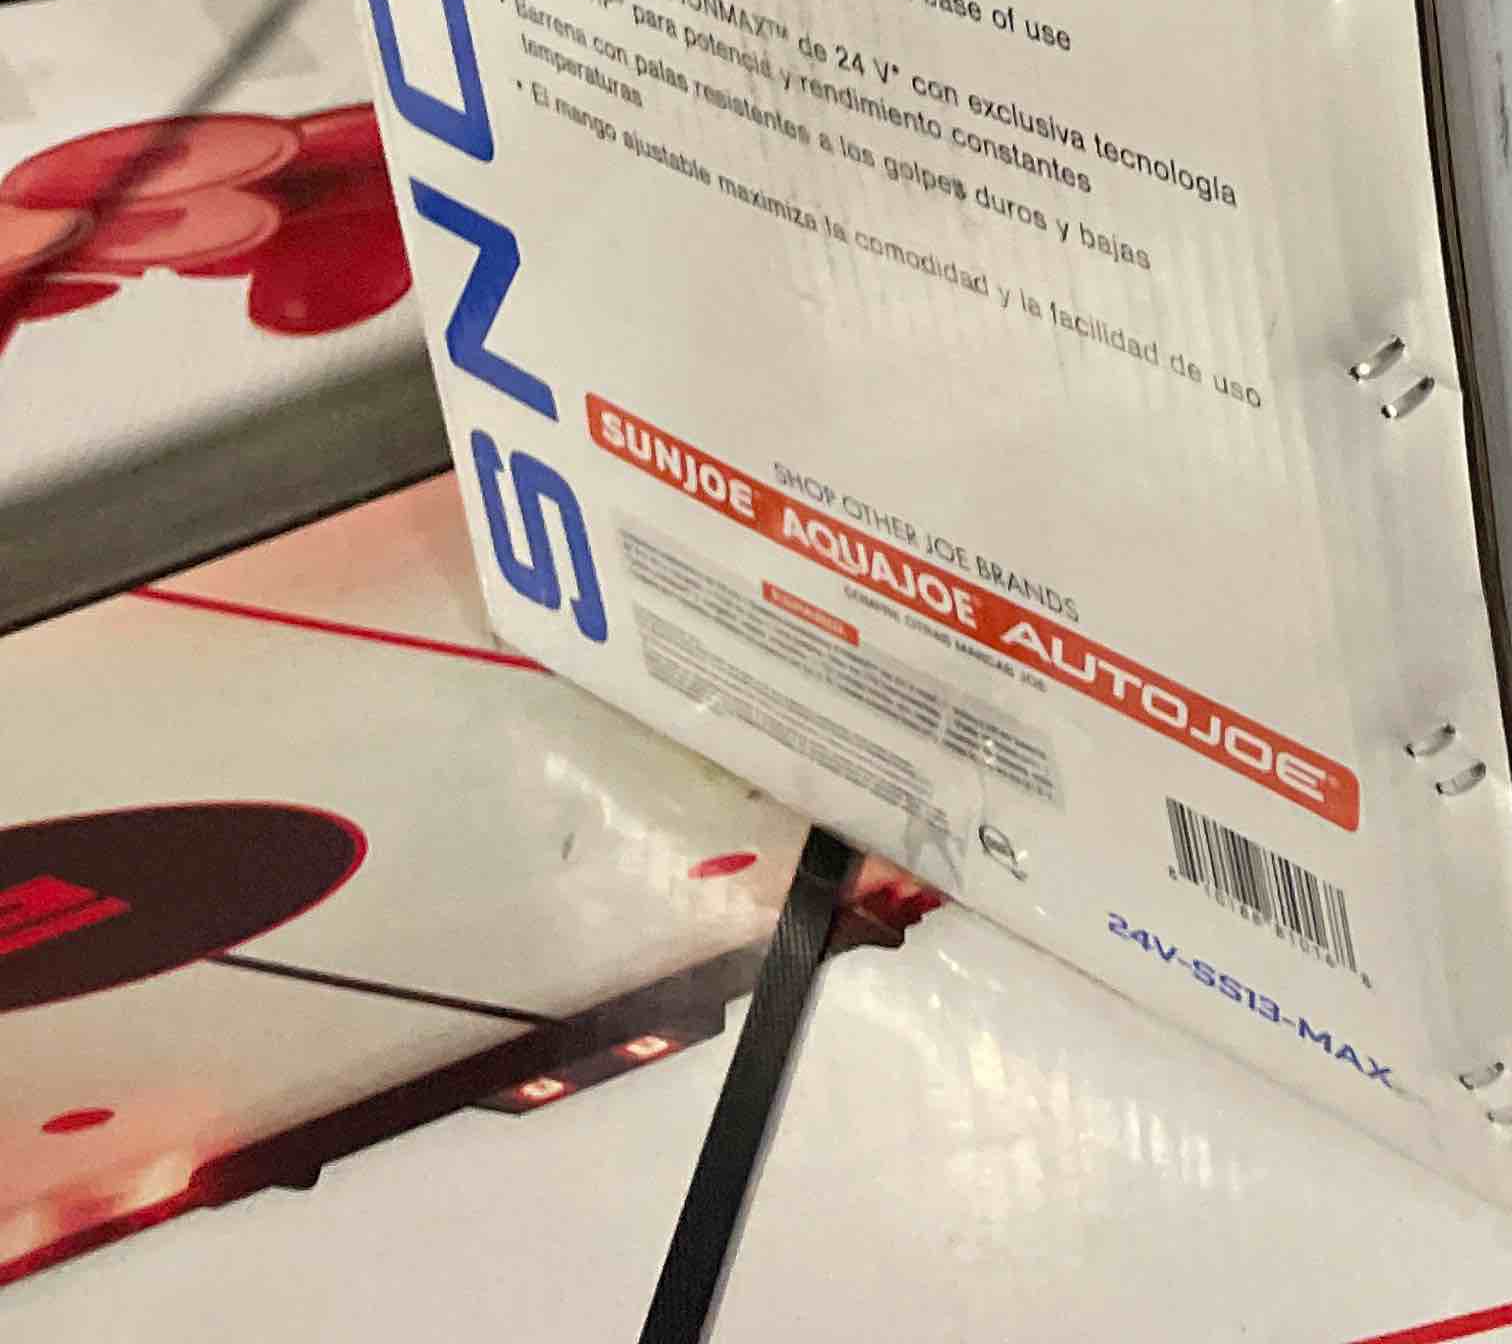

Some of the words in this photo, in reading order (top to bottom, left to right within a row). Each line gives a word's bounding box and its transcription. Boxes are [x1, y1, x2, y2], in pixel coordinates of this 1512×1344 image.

[520, 31, 644, 109] temperaturas
[631, 3, 679, 41] para
[779, 69, 792, 92] y
[799, 73, 944, 142] rendimiento
[951, 124, 1094, 196] constantes
[797, 34, 828, 65] de
[834, 44, 866, 79] 24
[911, 71, 960, 109] con
[967, 89, 1087, 153] exclusiva
[991, 6, 1017, 33] of
[1023, 20, 1073, 52] use
[592, 34, 630, 68] con
[634, 52, 690, 95] palas
[693, 79, 812, 147] resistentes
[818, 128, 836, 155] a
[838, 133, 876, 170] los
[882, 151, 969, 204] golpes
[974, 181, 1049, 233] duros
[1055, 216, 1072, 244] y
[1078, 220, 1152, 273] bajas
[530, 79, 551, 110] El
[553, 94, 618, 144] mango
[621, 126, 712, 188] ajustable
[717, 172, 819, 233] maximiza
[823, 215, 850, 245] la
[853, 229, 991, 298] comodidad
[996, 287, 1012, 311] y
[1019, 284, 1043, 322] la
[1049, 300, 1161, 368] facilidad
[1168, 349, 1204, 384] de
[1211, 374, 1264, 411] uso
[600, 411, 758, 522] SUNJOE
[782, 504, 981, 630] AQUAJOE
[999, 620, 1332, 803] AUTOJOE
[771, 461, 839, 508] SHOP
[841, 493, 918, 546] OTHER
[921, 530, 978, 576] JOE
[975, 554, 1082, 625] BRANDS
[1107, 911, 1393, 1090] 24V-SS13-MAX
